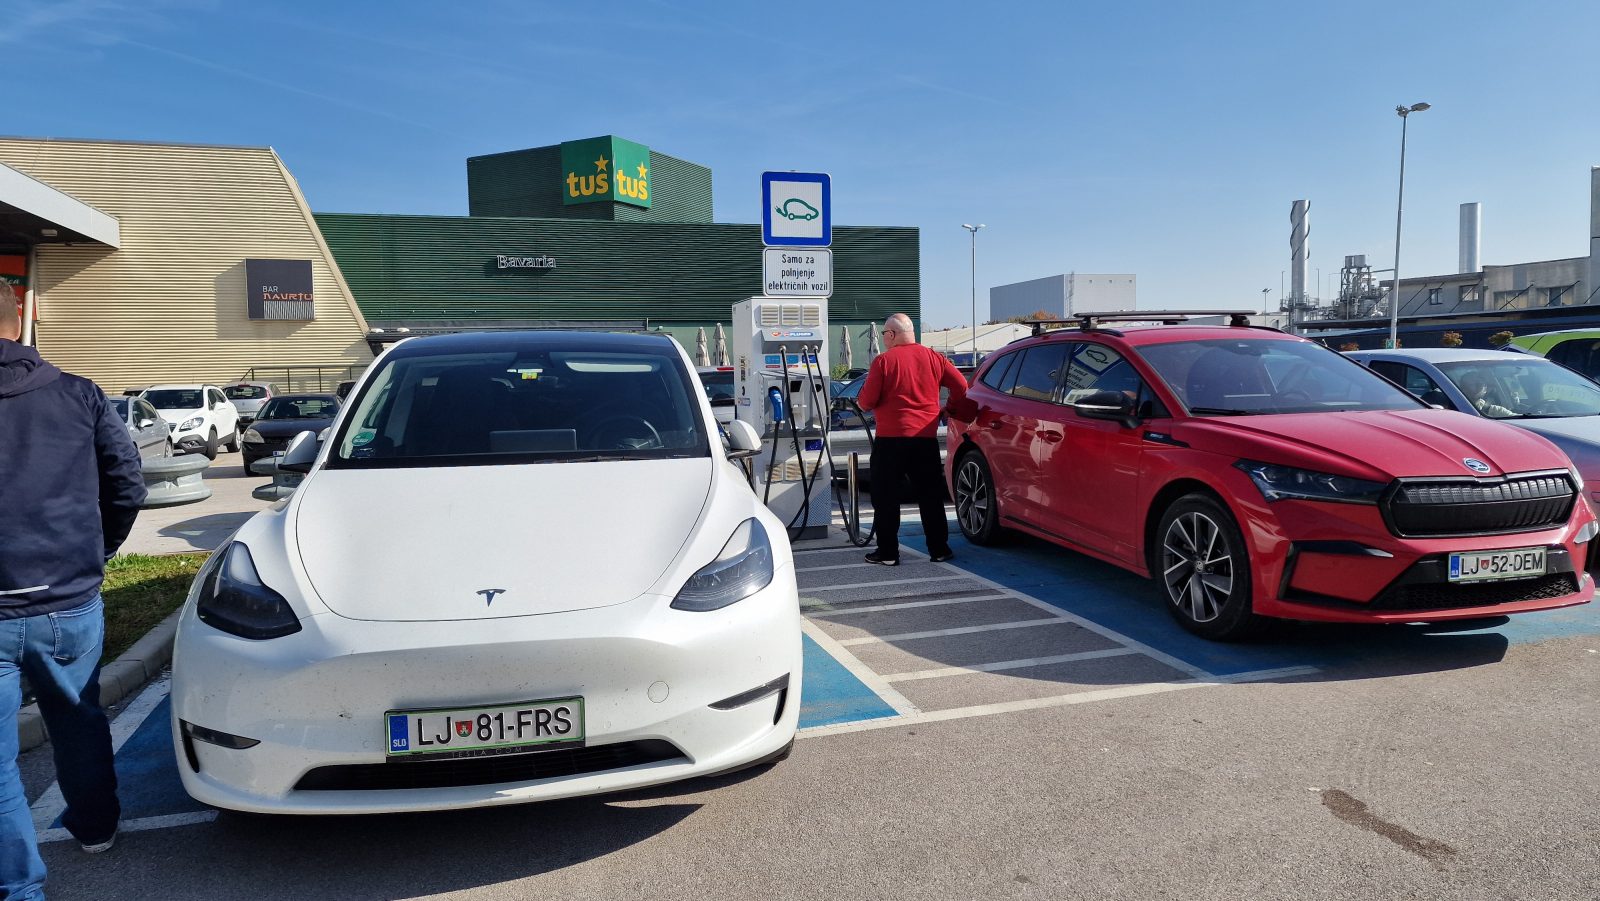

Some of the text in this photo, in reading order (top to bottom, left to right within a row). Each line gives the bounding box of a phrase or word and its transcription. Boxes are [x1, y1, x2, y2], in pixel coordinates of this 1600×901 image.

[497, 254, 557, 269] Bavaria
[781, 254, 815, 264] Samo za
[781, 268, 815, 280] polnjenje
[262, 285, 279, 293] BAR
[768, 281, 828, 291] električnih vozil
[1461, 551, 1543, 575] LJ 52-DEM
[417, 706, 572, 746] LJ 81-FRS
